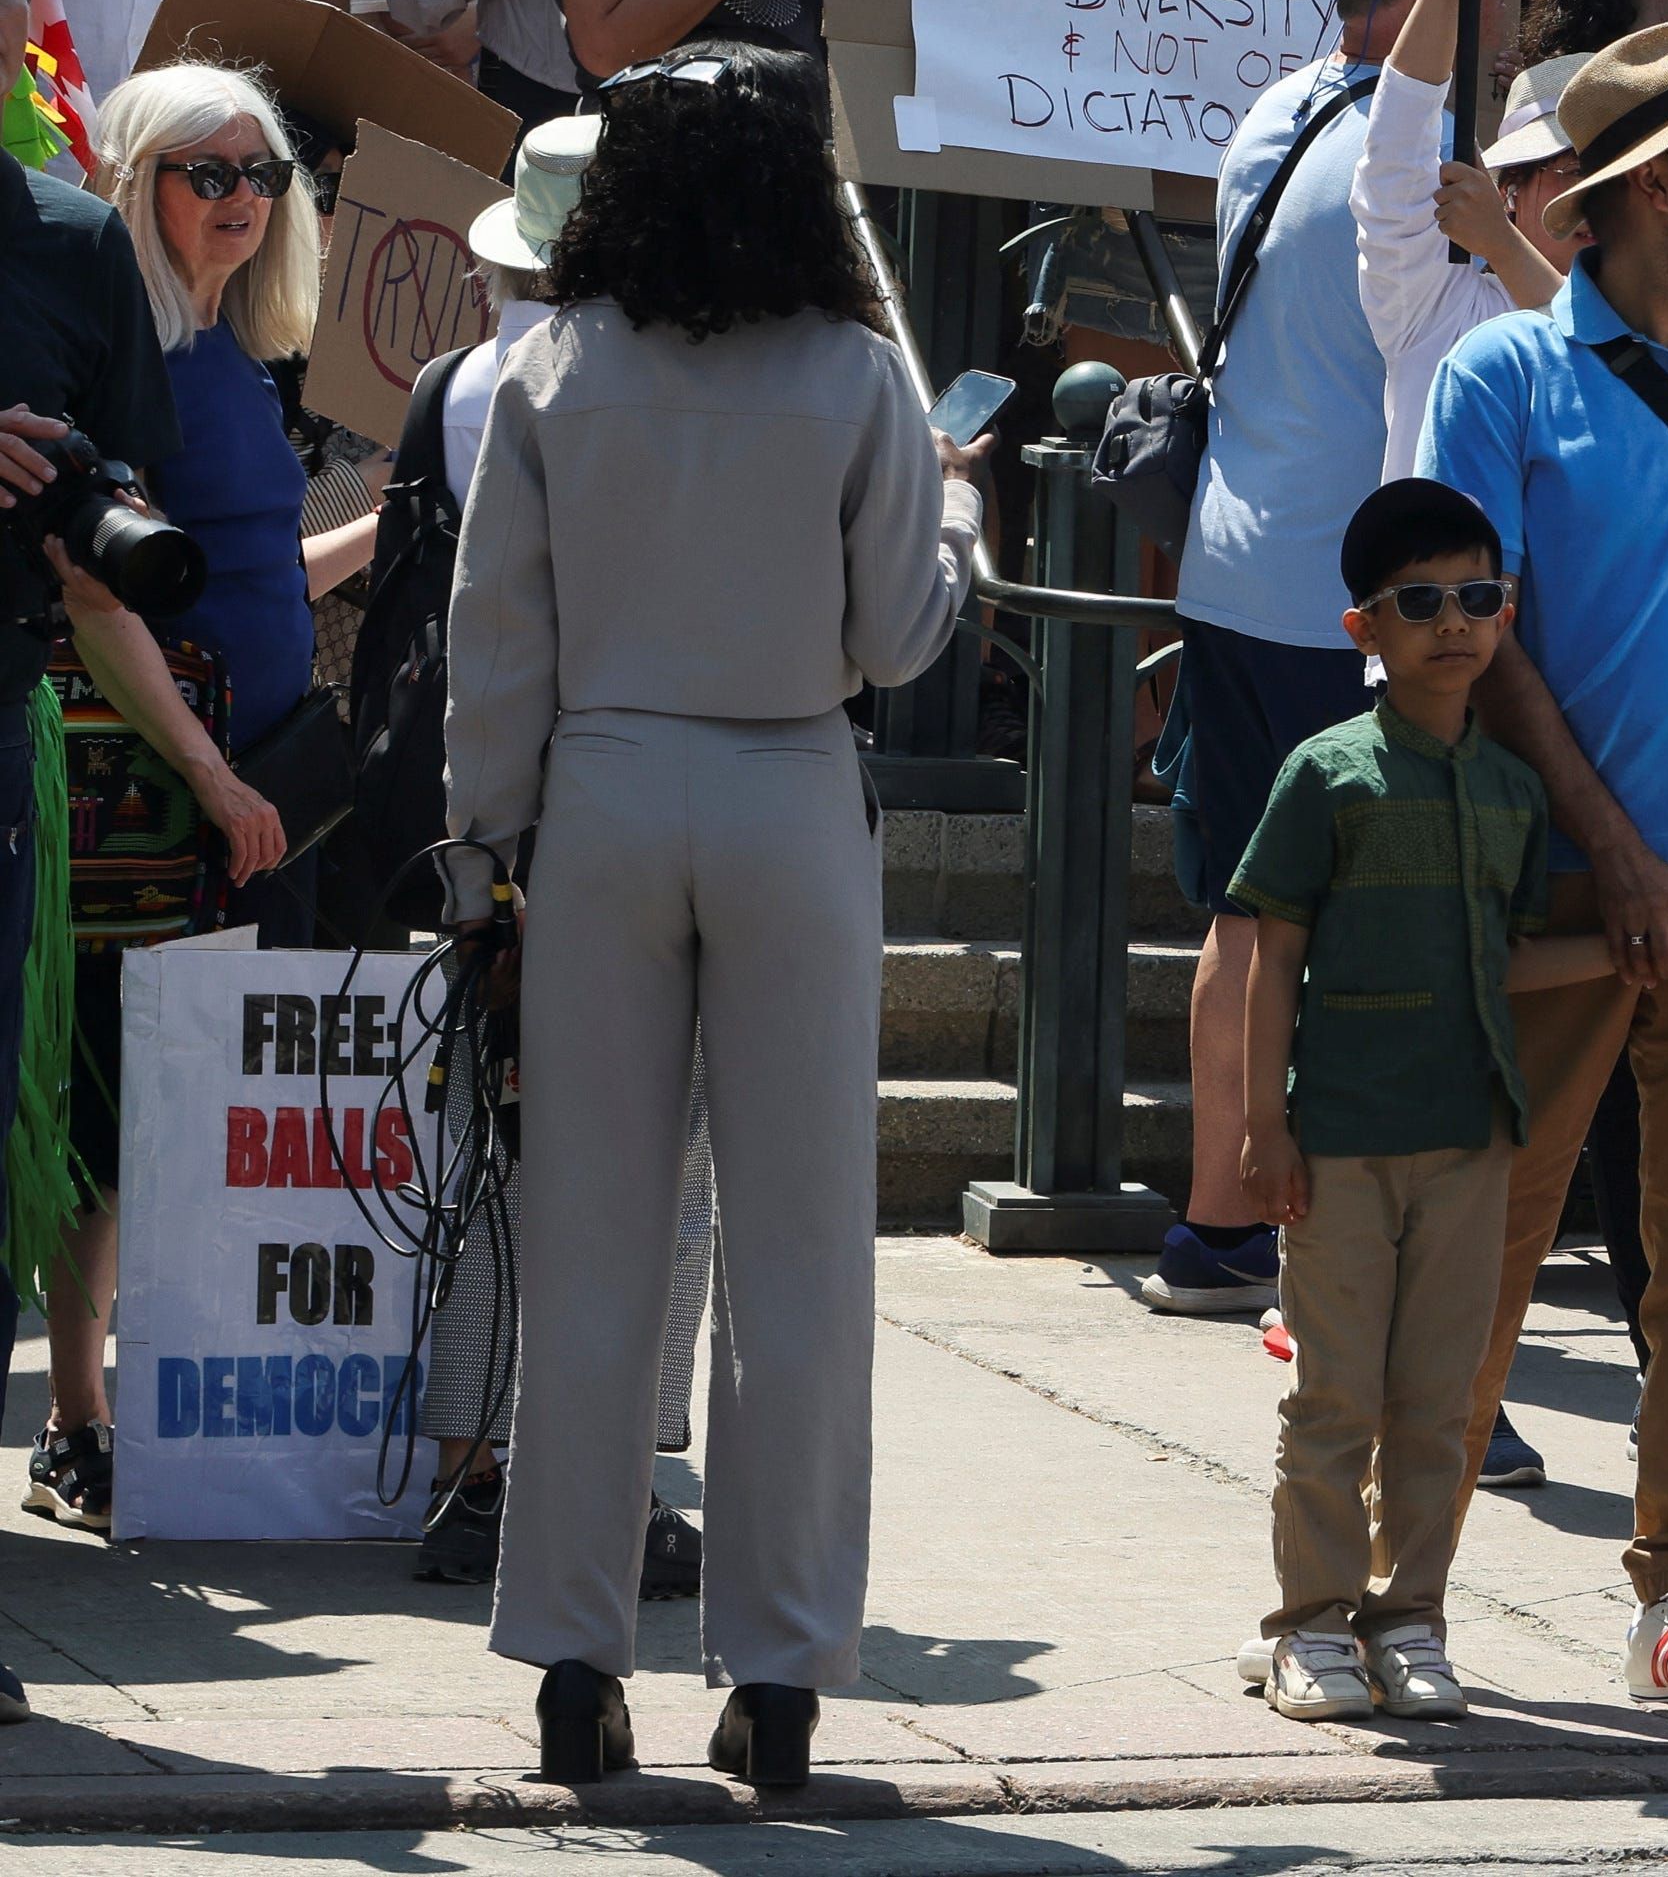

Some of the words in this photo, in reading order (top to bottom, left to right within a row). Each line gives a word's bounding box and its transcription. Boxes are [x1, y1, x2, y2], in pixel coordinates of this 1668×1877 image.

[1113, 30, 1210, 79] NOT
[241, 994, 400, 1076] FREE
[225, 1106, 414, 1190] BALLS
[256, 1242, 374, 1326] FOR
